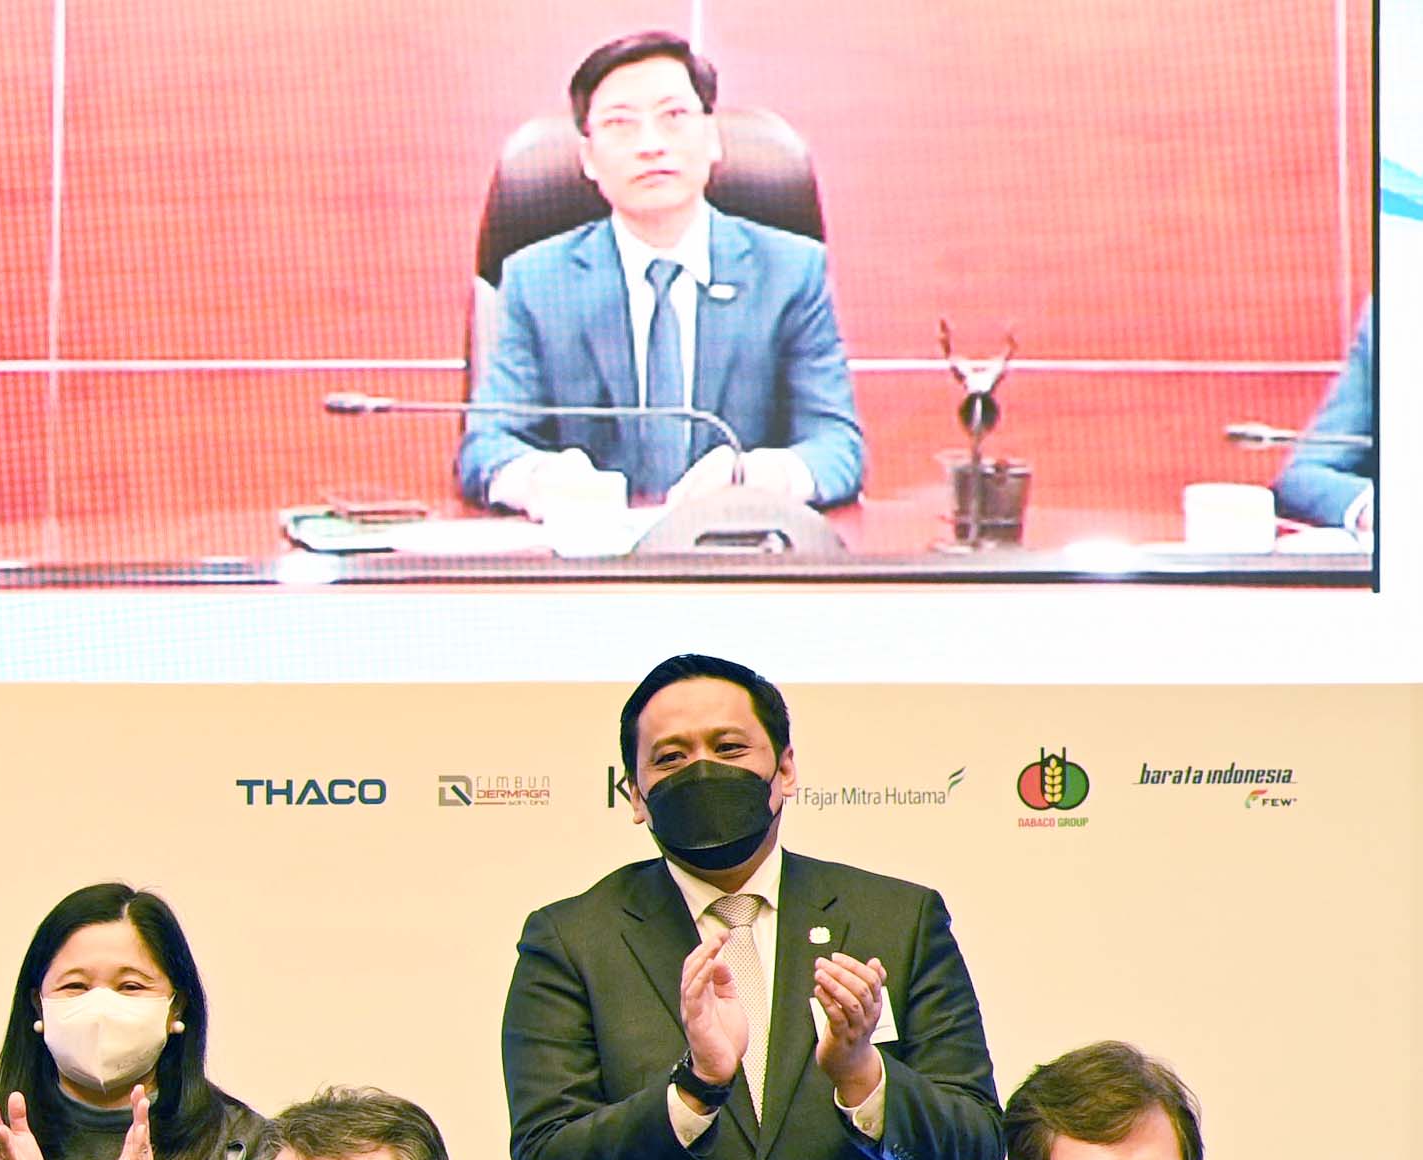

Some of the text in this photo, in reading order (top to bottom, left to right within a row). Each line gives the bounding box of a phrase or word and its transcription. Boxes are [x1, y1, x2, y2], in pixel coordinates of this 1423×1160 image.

[1139, 762, 1294, 785] barata indonesia
[236, 778, 387, 806] THACO
[476, 789, 550, 799] DERMAGA
[804, 787, 838, 810] Fajar
[841, 787, 882, 805] Mitra
[885, 787, 946, 805] Hutama
[1017, 817, 1089, 828] DABACO GROUP
